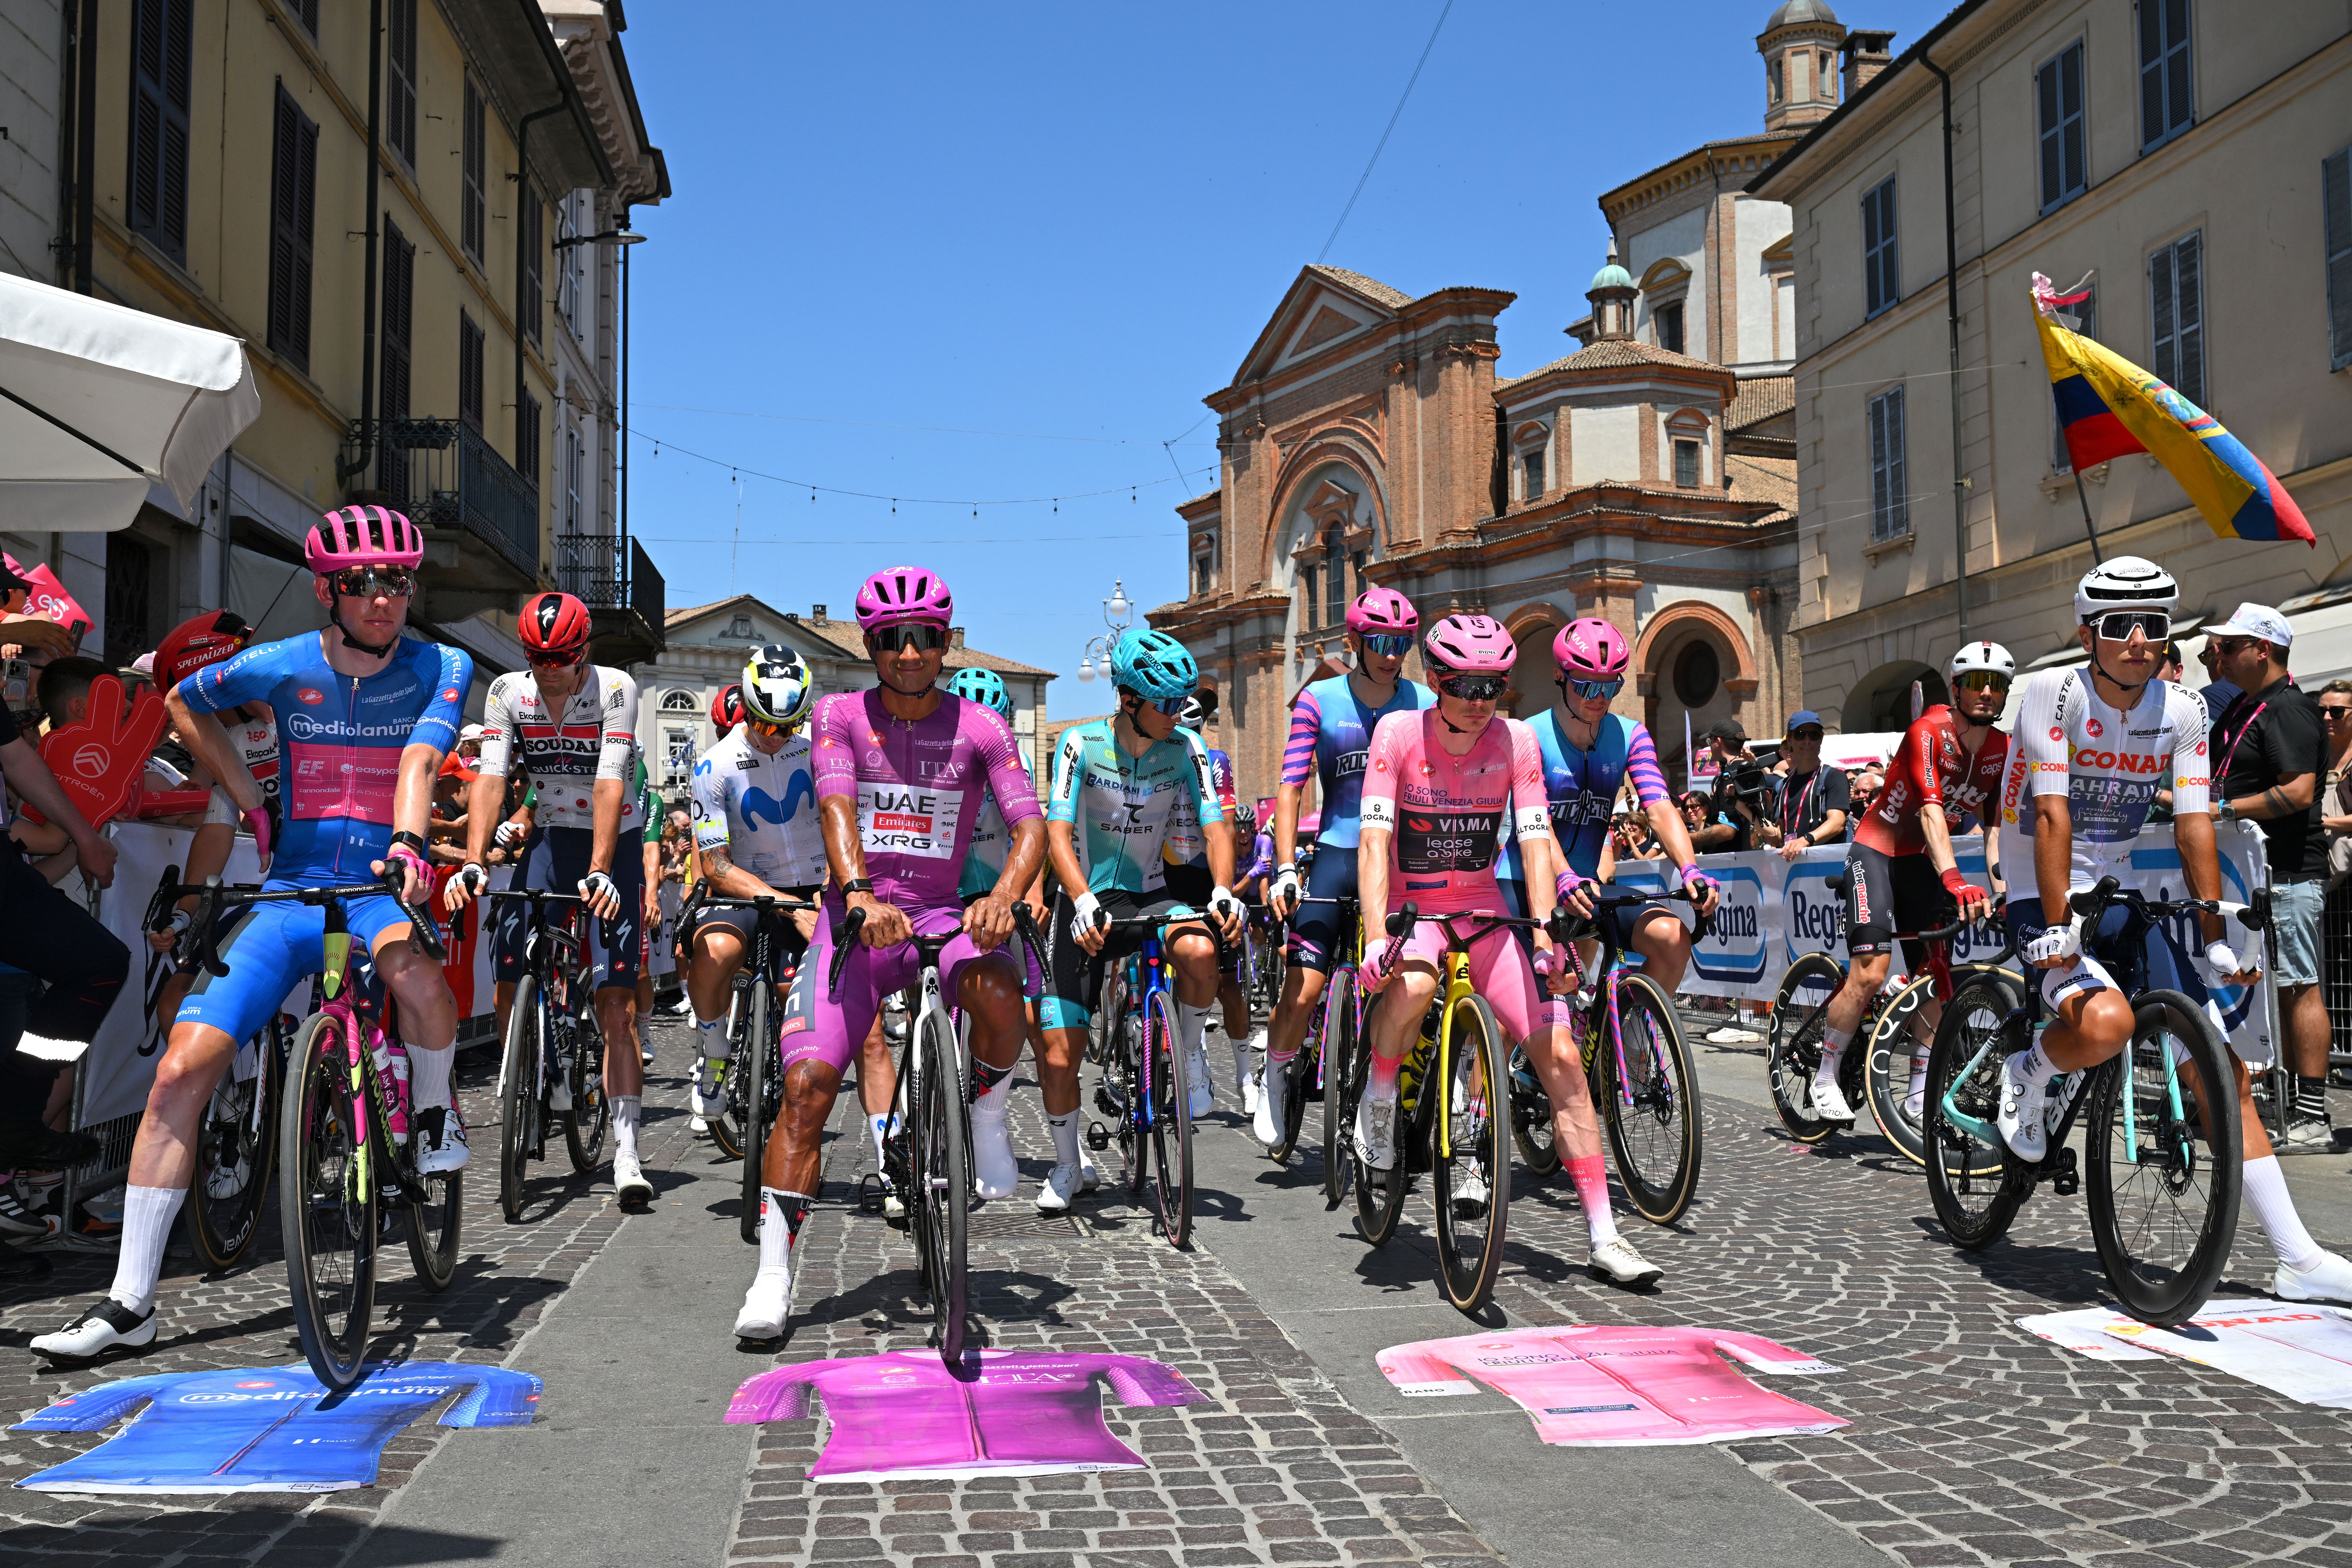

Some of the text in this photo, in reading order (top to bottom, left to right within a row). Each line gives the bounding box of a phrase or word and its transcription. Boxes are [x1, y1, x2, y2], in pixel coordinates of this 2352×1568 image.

[2117, 567, 2151, 575] AMACX
[862, 581, 874, 601] MET
[931, 575, 942, 598] MET
[1364, 596, 1382, 611] KASK
[2262, 627, 2273, 635] d'Italia
[1571, 632, 1589, 653] KASK
[177, 643, 234, 670] SPECIALIZED
[224, 644, 281, 676] CASTELLI
[431, 642, 462, 683] CASTELLI
[1141, 650, 1163, 671] BRIKO
[368, 693, 392, 704] Gazzetta
[392, 690, 405, 699] dello
[405, 683, 416, 698] Sport
[490, 679, 504, 697] SAFETY
[494, 681, 507, 698] JOGGER
[617, 688, 625, 708] SAFETY
[2055, 671, 2075, 721] CASTELLI
[519, 711, 548, 722] Ekopak
[821, 694, 848, 731] CASTELLI
[2172, 684, 2207, 735] CASTELLI
[289, 713, 414, 739] mediolanum
[393, 716, 416, 725] BANCA
[1337, 720, 1363, 729] Santini
[976, 708, 1013, 752] CASTELLI
[1379, 712, 1410, 753] CASTELLI
[2161, 726, 2173, 735] Sport
[526, 739, 601, 754] SOUDAL
[953, 737, 965, 746] Sport
[1507, 720, 1537, 764] CASTELLI
[780, 747, 809, 760] CANYON
[1983, 753, 2004, 761] ORBEA
[2076, 748, 2170, 774] CONAD
[918, 760, 959, 778] ITA
[1151, 766, 1175, 777] ROSA
[1497, 761, 1506, 771] Sport
[1552, 766, 1576, 777] Santini
[1944, 761, 1962, 772] NIPPO
[1981, 761, 2002, 776] caps
[1085, 772, 1140, 794] BARDIANI
[1154, 778, 1181, 793] CSF
[1405, 783, 1448, 797] IO SONO
[875, 791, 937, 815] UAE
[1403, 793, 1503, 806] FRIULI VENEZIA GIULIA
[1057, 807, 1072, 815] FTC
[879, 817, 926, 829] Emirates
[1100, 823, 1153, 834] SABER
[1439, 818, 1490, 832] VISMA
[871, 834, 931, 849] XRG
[1427, 837, 1473, 849] lease
[336, 885, 375, 894] cannondale
[1031, 937, 1047, 970] DURA-ACE
[1383, 935, 1403, 967] SRAM
[1568, 942, 1583, 973] SRAM
[2050, 972, 2094, 1000] Bianchi
[1956, 989, 1995, 1012] Vision
[1819, 1108, 1843, 1118] nimbl
[1353, 1137, 1380, 1165] nimbl
[1537, 1351, 1613, 1364] VENEZIA
[973, 1373, 1058, 1385] ITA
